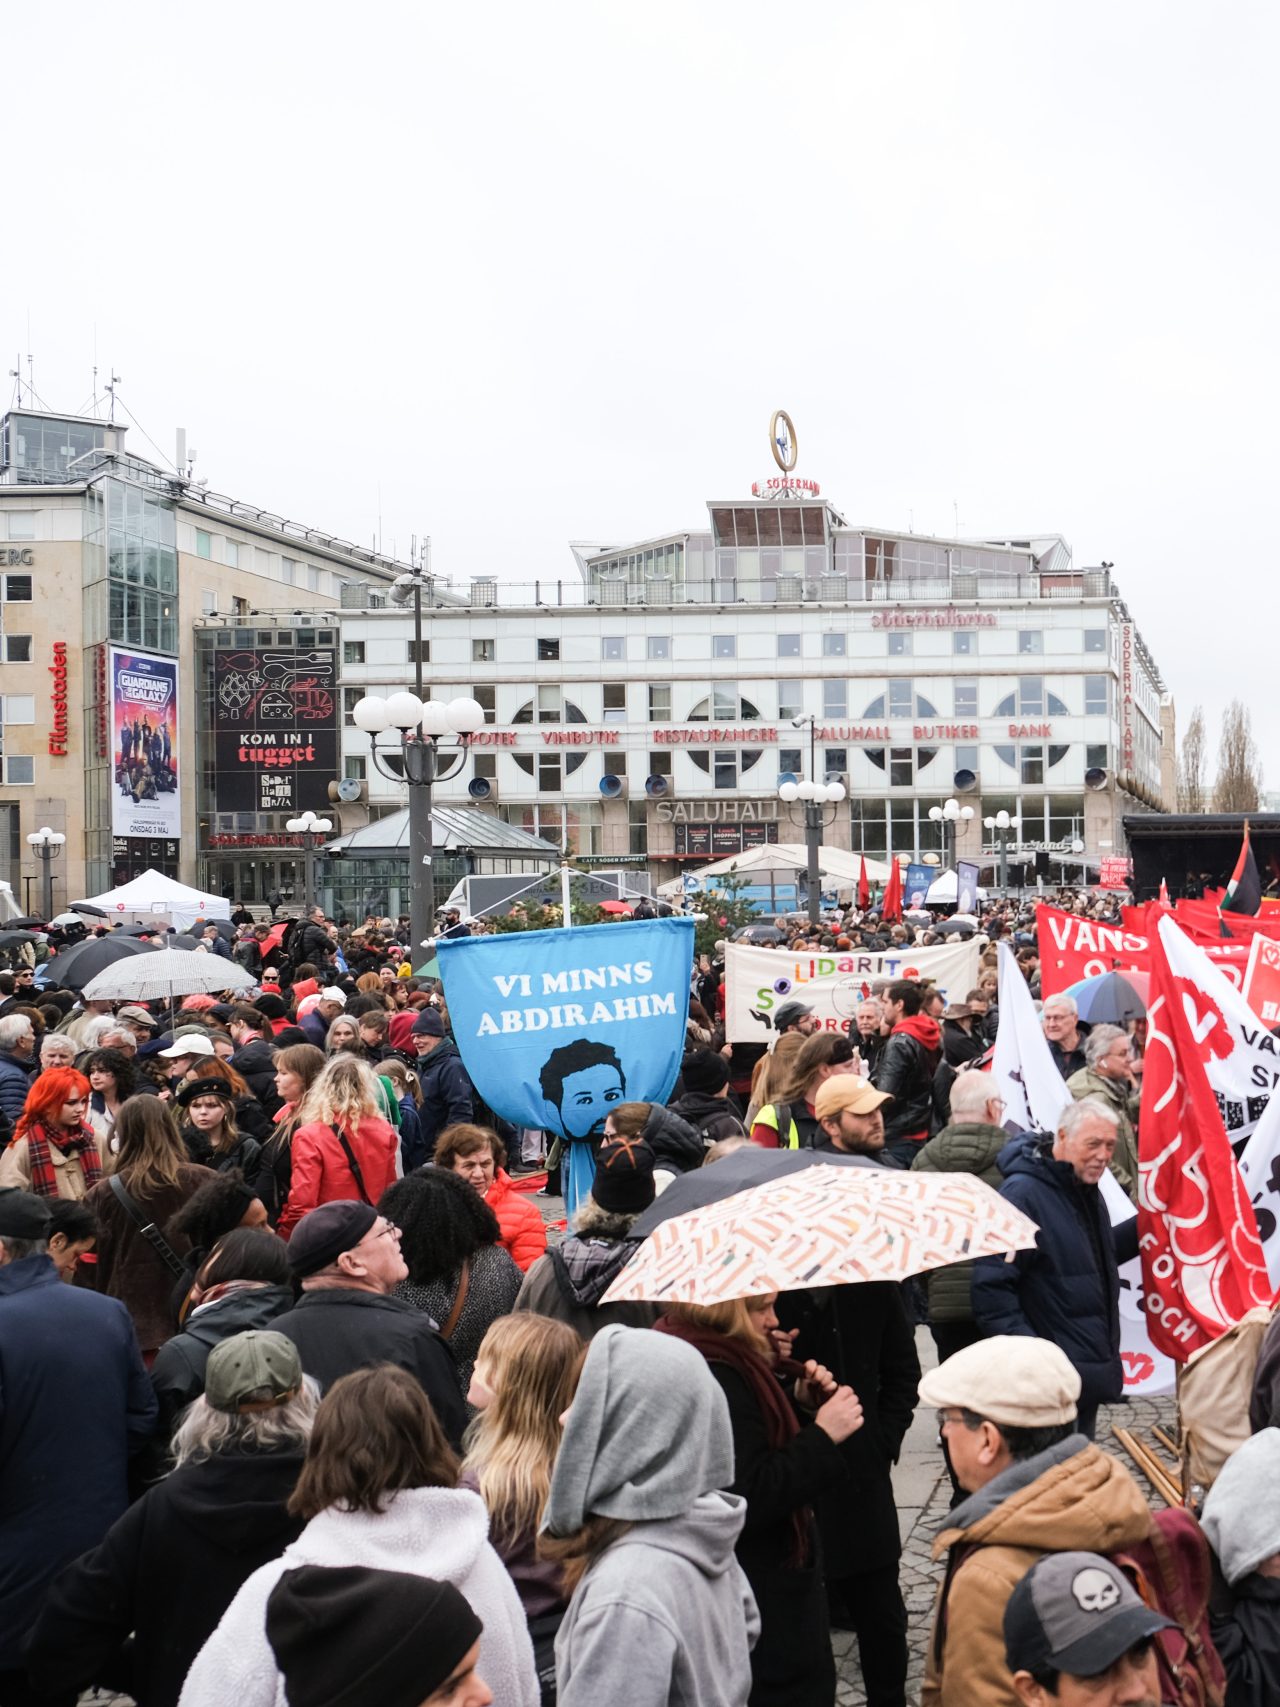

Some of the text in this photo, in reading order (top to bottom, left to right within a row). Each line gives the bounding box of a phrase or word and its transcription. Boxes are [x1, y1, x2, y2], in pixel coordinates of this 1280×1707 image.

[121, 674, 168, 692] GUARDIANS
[48, 641, 68, 756] Filmstaden
[132, 688, 166, 703] GALAXY
[1122, 625, 1133, 771] SÖDERHALLARNA
[240, 733, 313, 745] KOM IN I
[541, 730, 620, 745] VINBUTIK
[653, 727, 779, 744] RESTAURANGER
[813, 726, 892, 741] SALUHALL
[913, 724, 979, 740] BUTIKER
[1008, 723, 1053, 738] BANK
[238, 744, 316, 768] tugget
[656, 800, 786, 823] SALUHALL
[130, 825, 152, 833] ONSDAG
[493, 961, 653, 998] VI MINNS
[476, 992, 677, 1037] ABDIRAHIM
[1146, 1293, 1198, 1343] OCH
